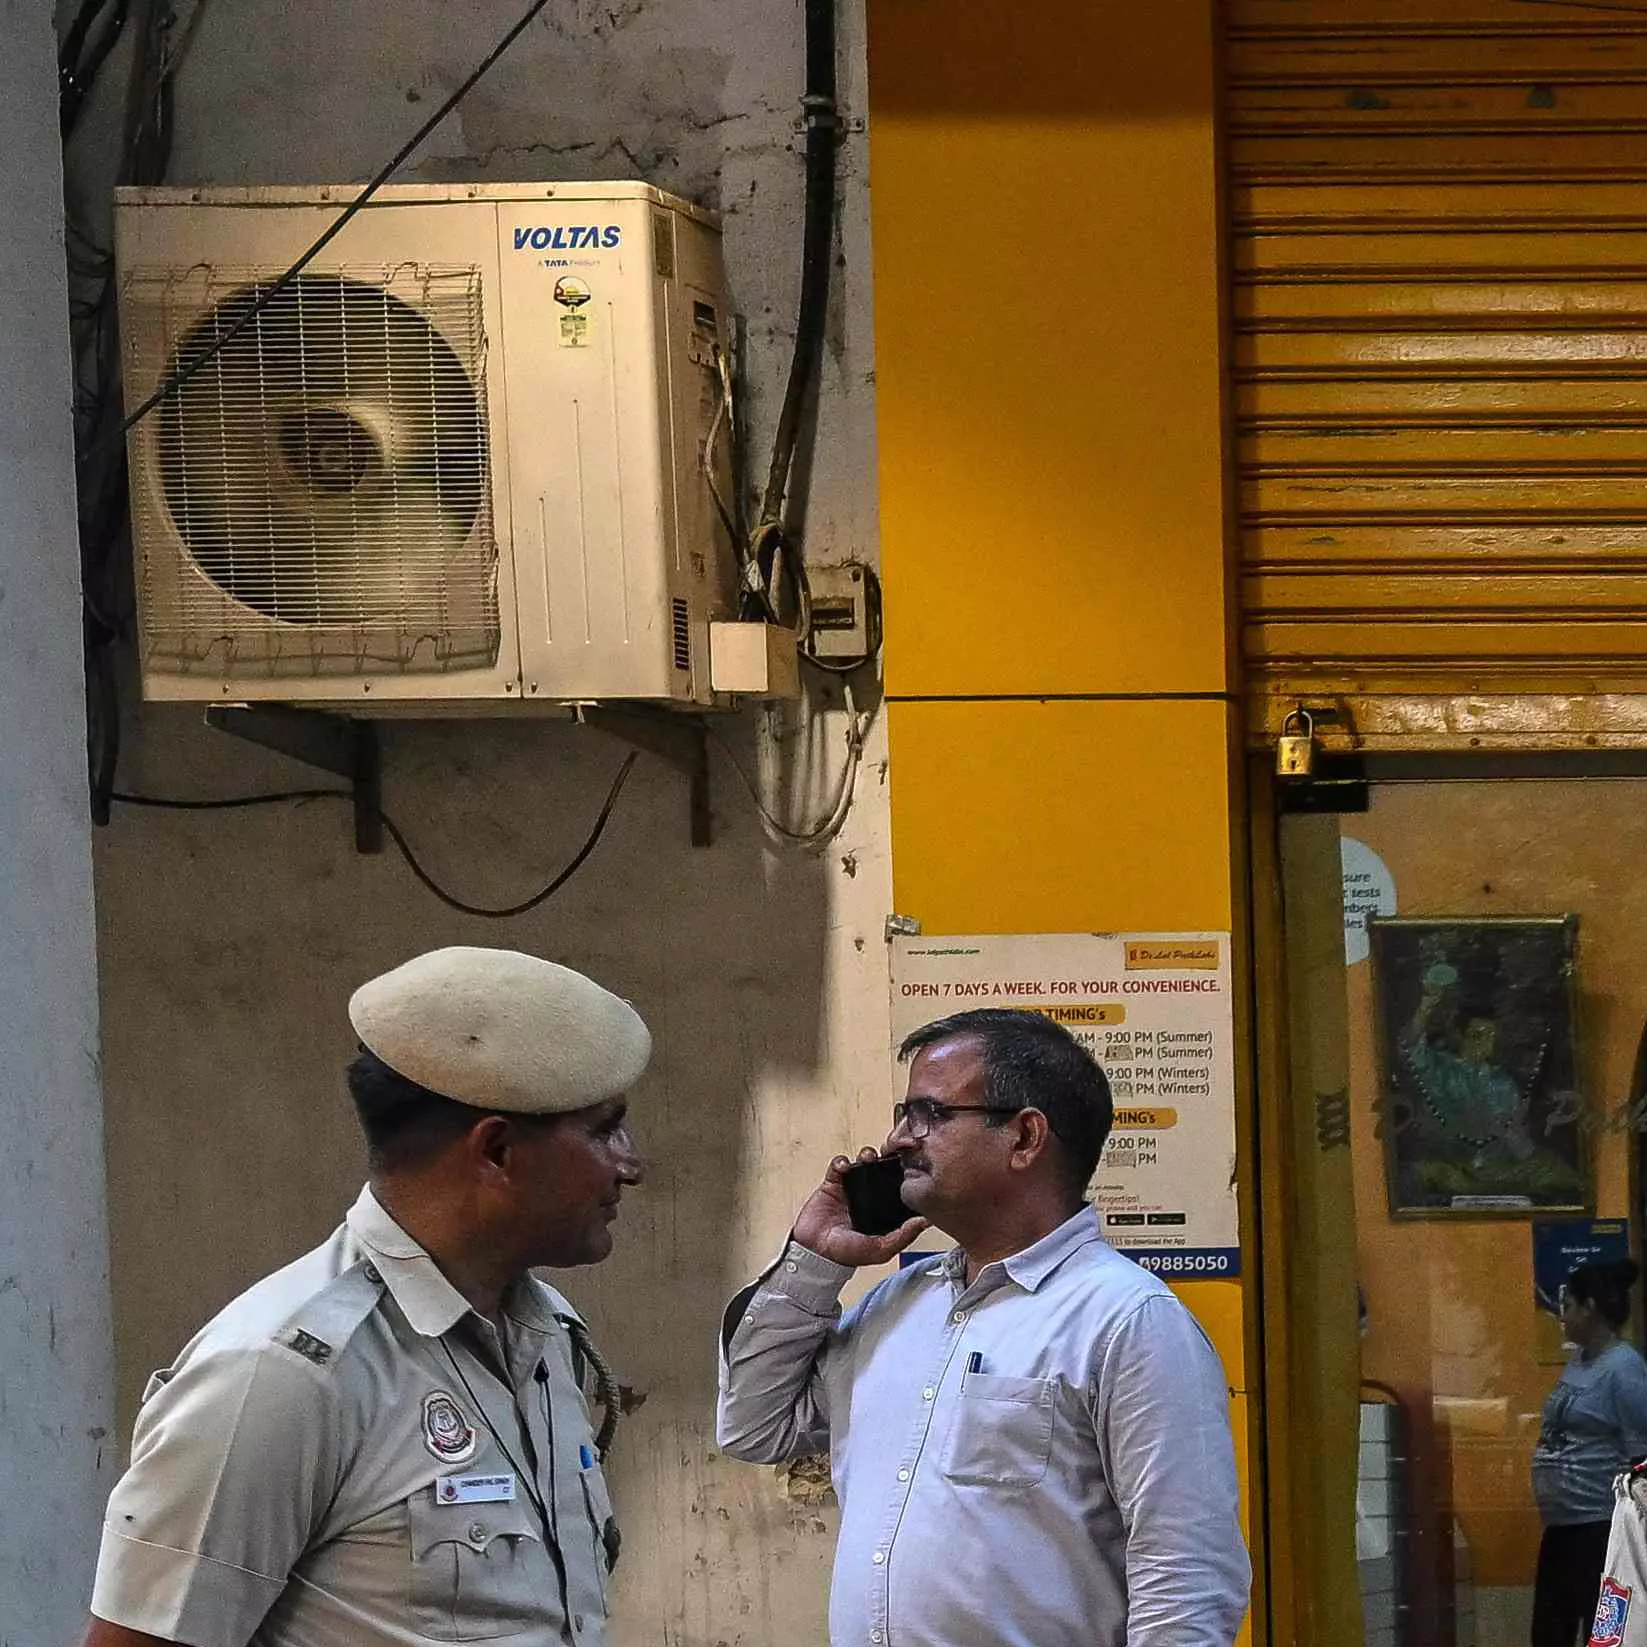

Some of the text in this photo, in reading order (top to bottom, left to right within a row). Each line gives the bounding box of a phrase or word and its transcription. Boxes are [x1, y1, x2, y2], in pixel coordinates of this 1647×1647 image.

[514, 226, 621, 250] VOLTAS
[901, 979, 1220, 997] OPEN 7 DAYS A WEEK. FOR YOUR CONVENIENCE.
[1048, 1007, 1105, 1020] TIMING's
[1105, 1031, 1130, 1042] 9:00
[1135, 1031, 1152, 1042] PM
[1156, 1030, 1213, 1045] (Summer)
[1135, 1047, 1152, 1058] PM
[1157, 1046, 1213, 1060] (Summer)
[1107, 1066, 1209, 1081] 9:00 PM (Winters)
[1136, 1082, 1210, 1096] PM (Winters)
[1114, 1111, 1156, 1123] MING's
[1109, 1136, 1156, 1148] 9:00 PM
[1138, 1153, 1156, 1164] PM
